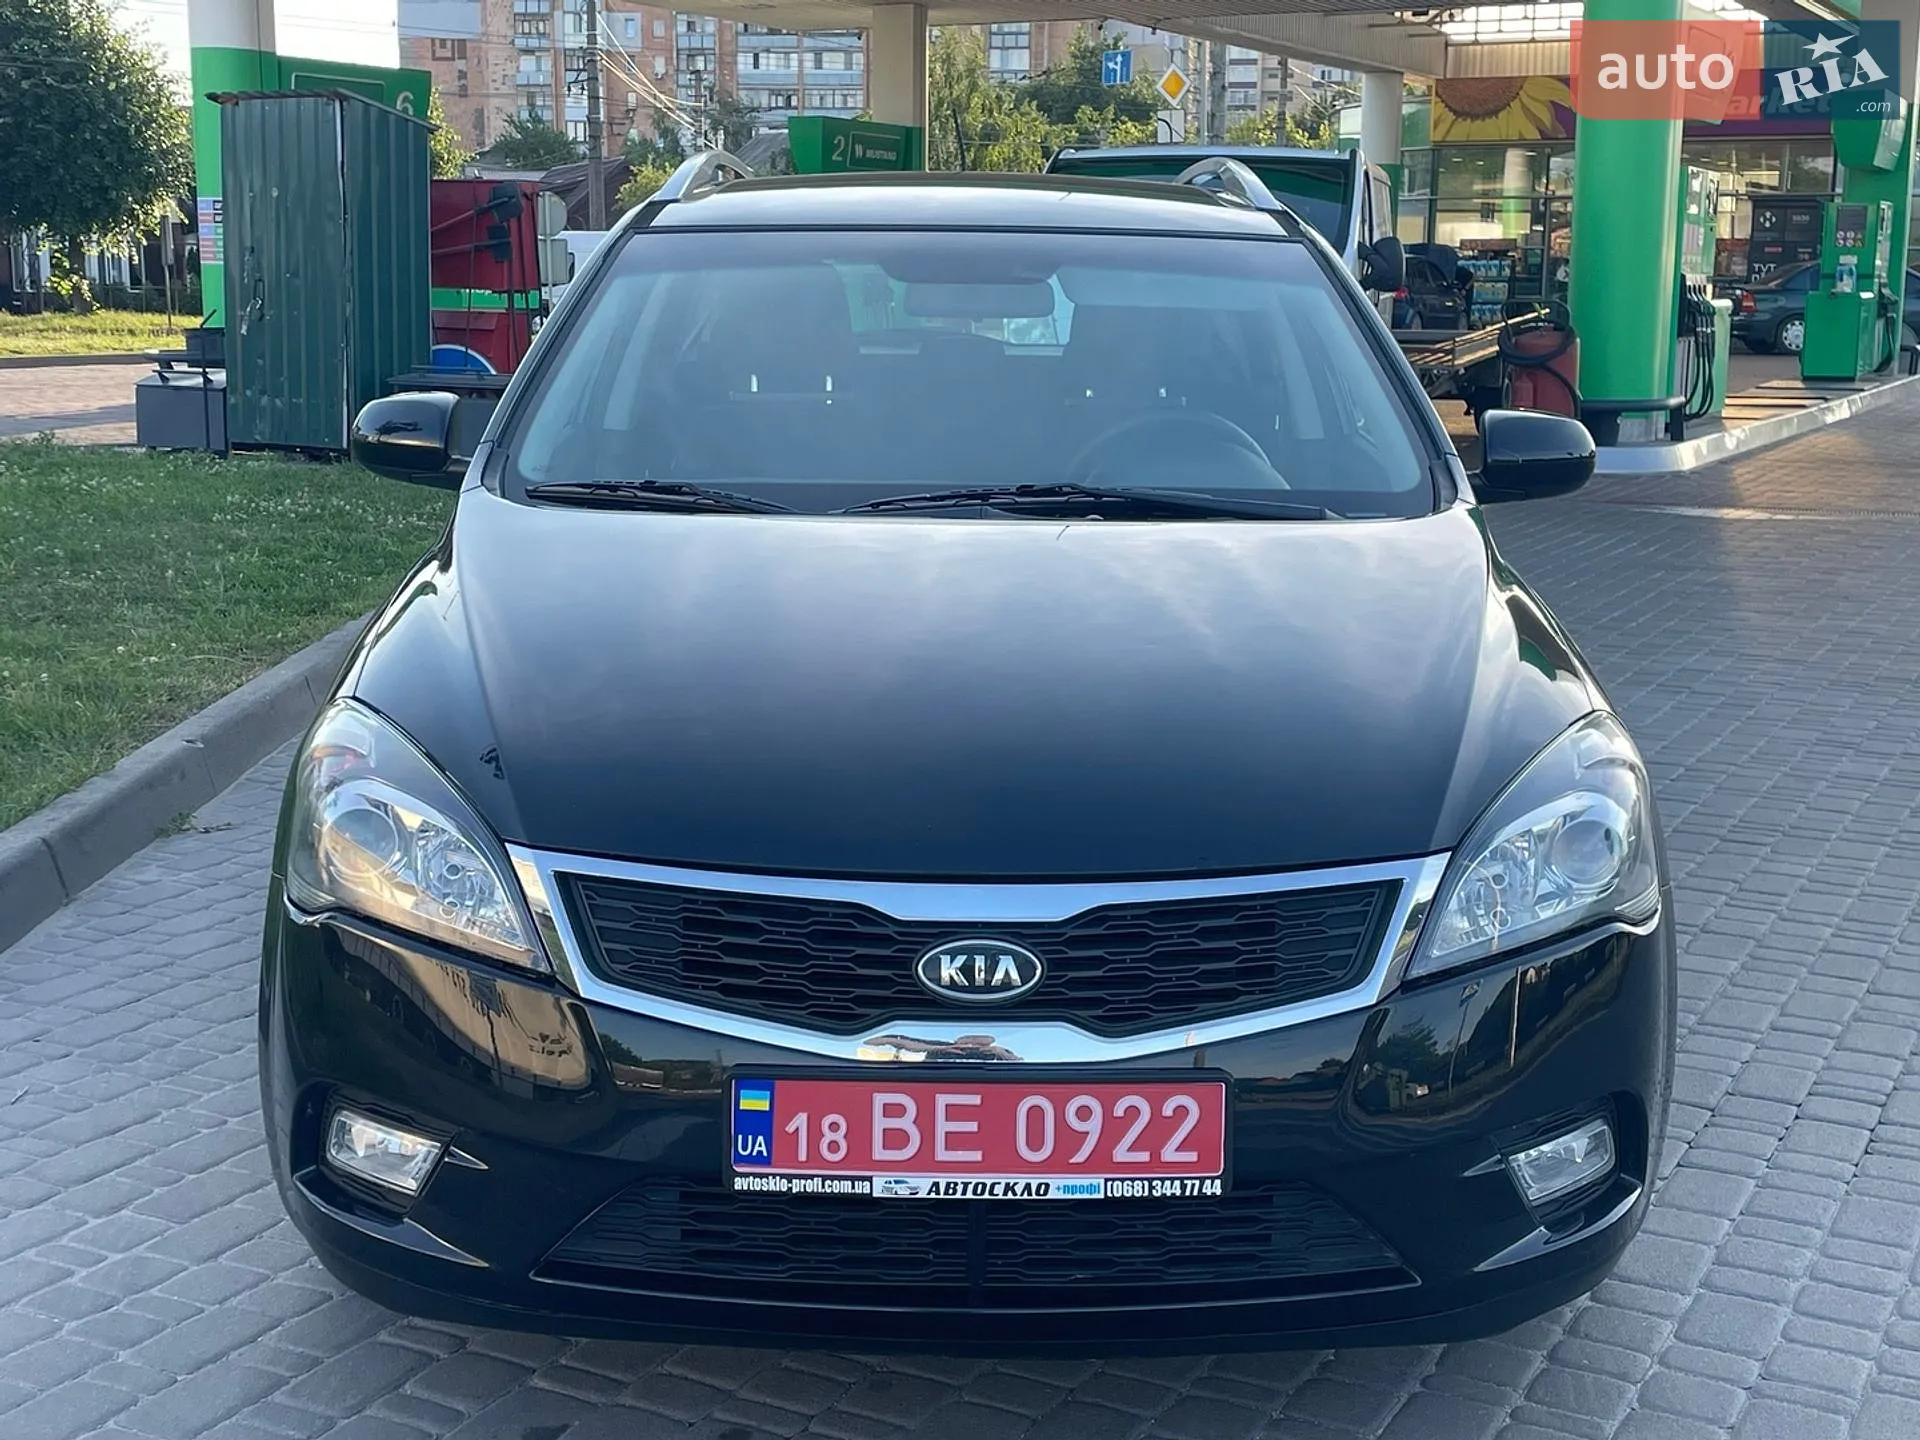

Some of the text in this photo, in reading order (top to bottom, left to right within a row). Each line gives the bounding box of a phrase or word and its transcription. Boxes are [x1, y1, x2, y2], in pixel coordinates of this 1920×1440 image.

[396, 91, 414, 116] 6
[1725, 87, 1831, 115] arket
[832, 135, 845, 161] 2
[940, 955, 1022, 987] KIA
[785, 1092, 1200, 1163] 18 BE 0922
[737, 1134, 768, 1157] UA
[733, 1175, 871, 1195] avtosklo-profi.com.ua
[1106, 1179, 1222, 1197] (068) 344 77 44
